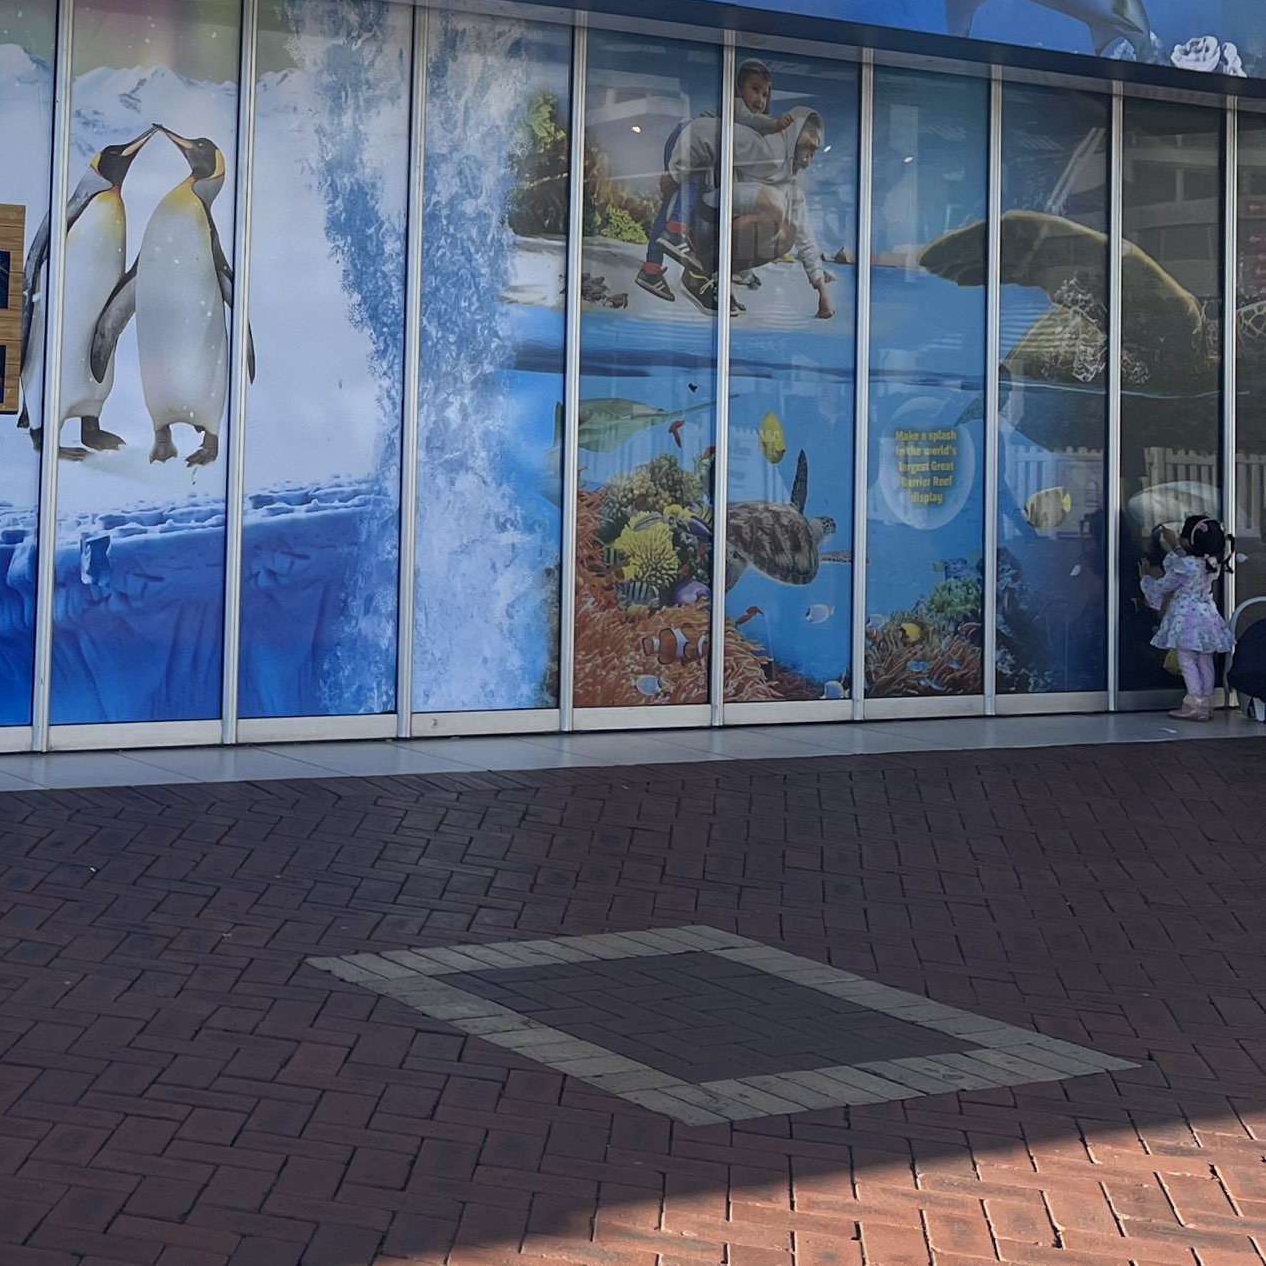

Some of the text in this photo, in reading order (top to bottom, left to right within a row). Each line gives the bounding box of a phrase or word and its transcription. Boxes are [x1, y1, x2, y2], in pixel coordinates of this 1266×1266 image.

[895, 430, 919, 441] Make
[928, 430, 957, 443] splash
[906, 446, 921, 456] the
[923, 445, 957, 456] world's
[899, 461, 954, 474] largest Great
[901, 475, 953, 488] Barrier Reef
[910, 491, 943, 504] display
